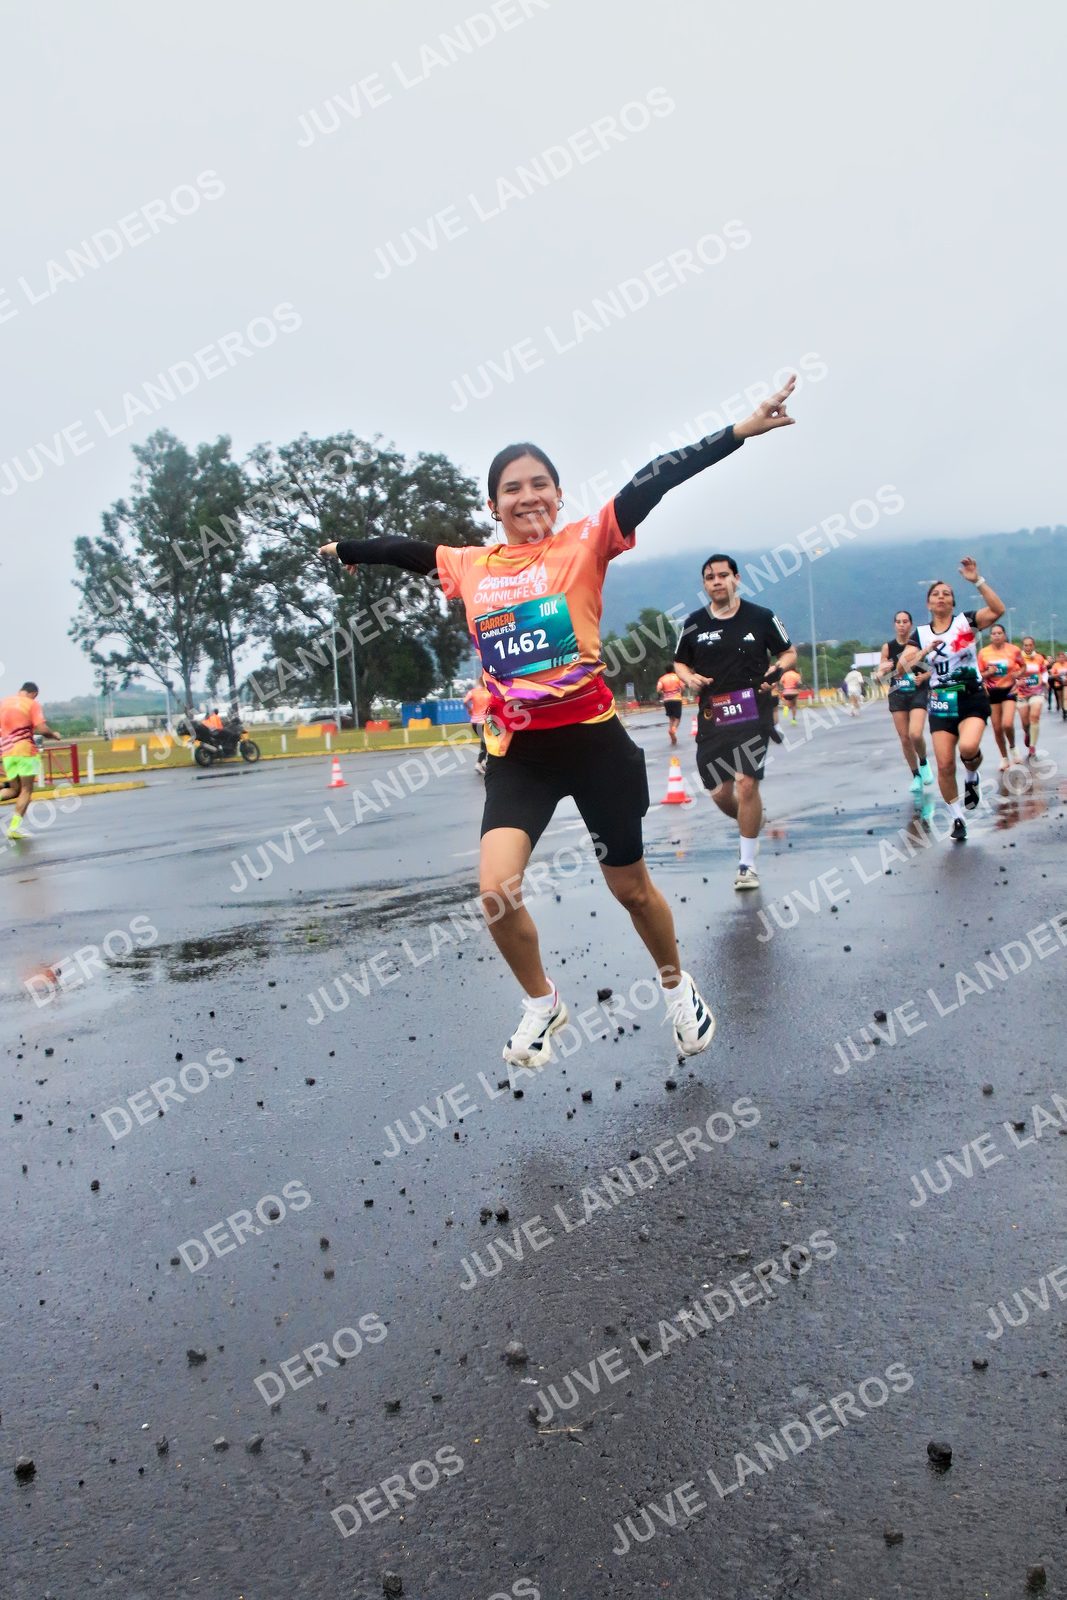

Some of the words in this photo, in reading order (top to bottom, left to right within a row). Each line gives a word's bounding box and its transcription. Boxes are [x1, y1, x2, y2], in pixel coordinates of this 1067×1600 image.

[474, 586, 530, 604] OMNILIFE
[539, 600, 558, 617] 10K
[480, 613, 515, 631] CARRERA
[482, 626, 509, 639] OMNILIFE
[494, 629, 549, 660] 1462
[722, 704, 742, 716] 381
